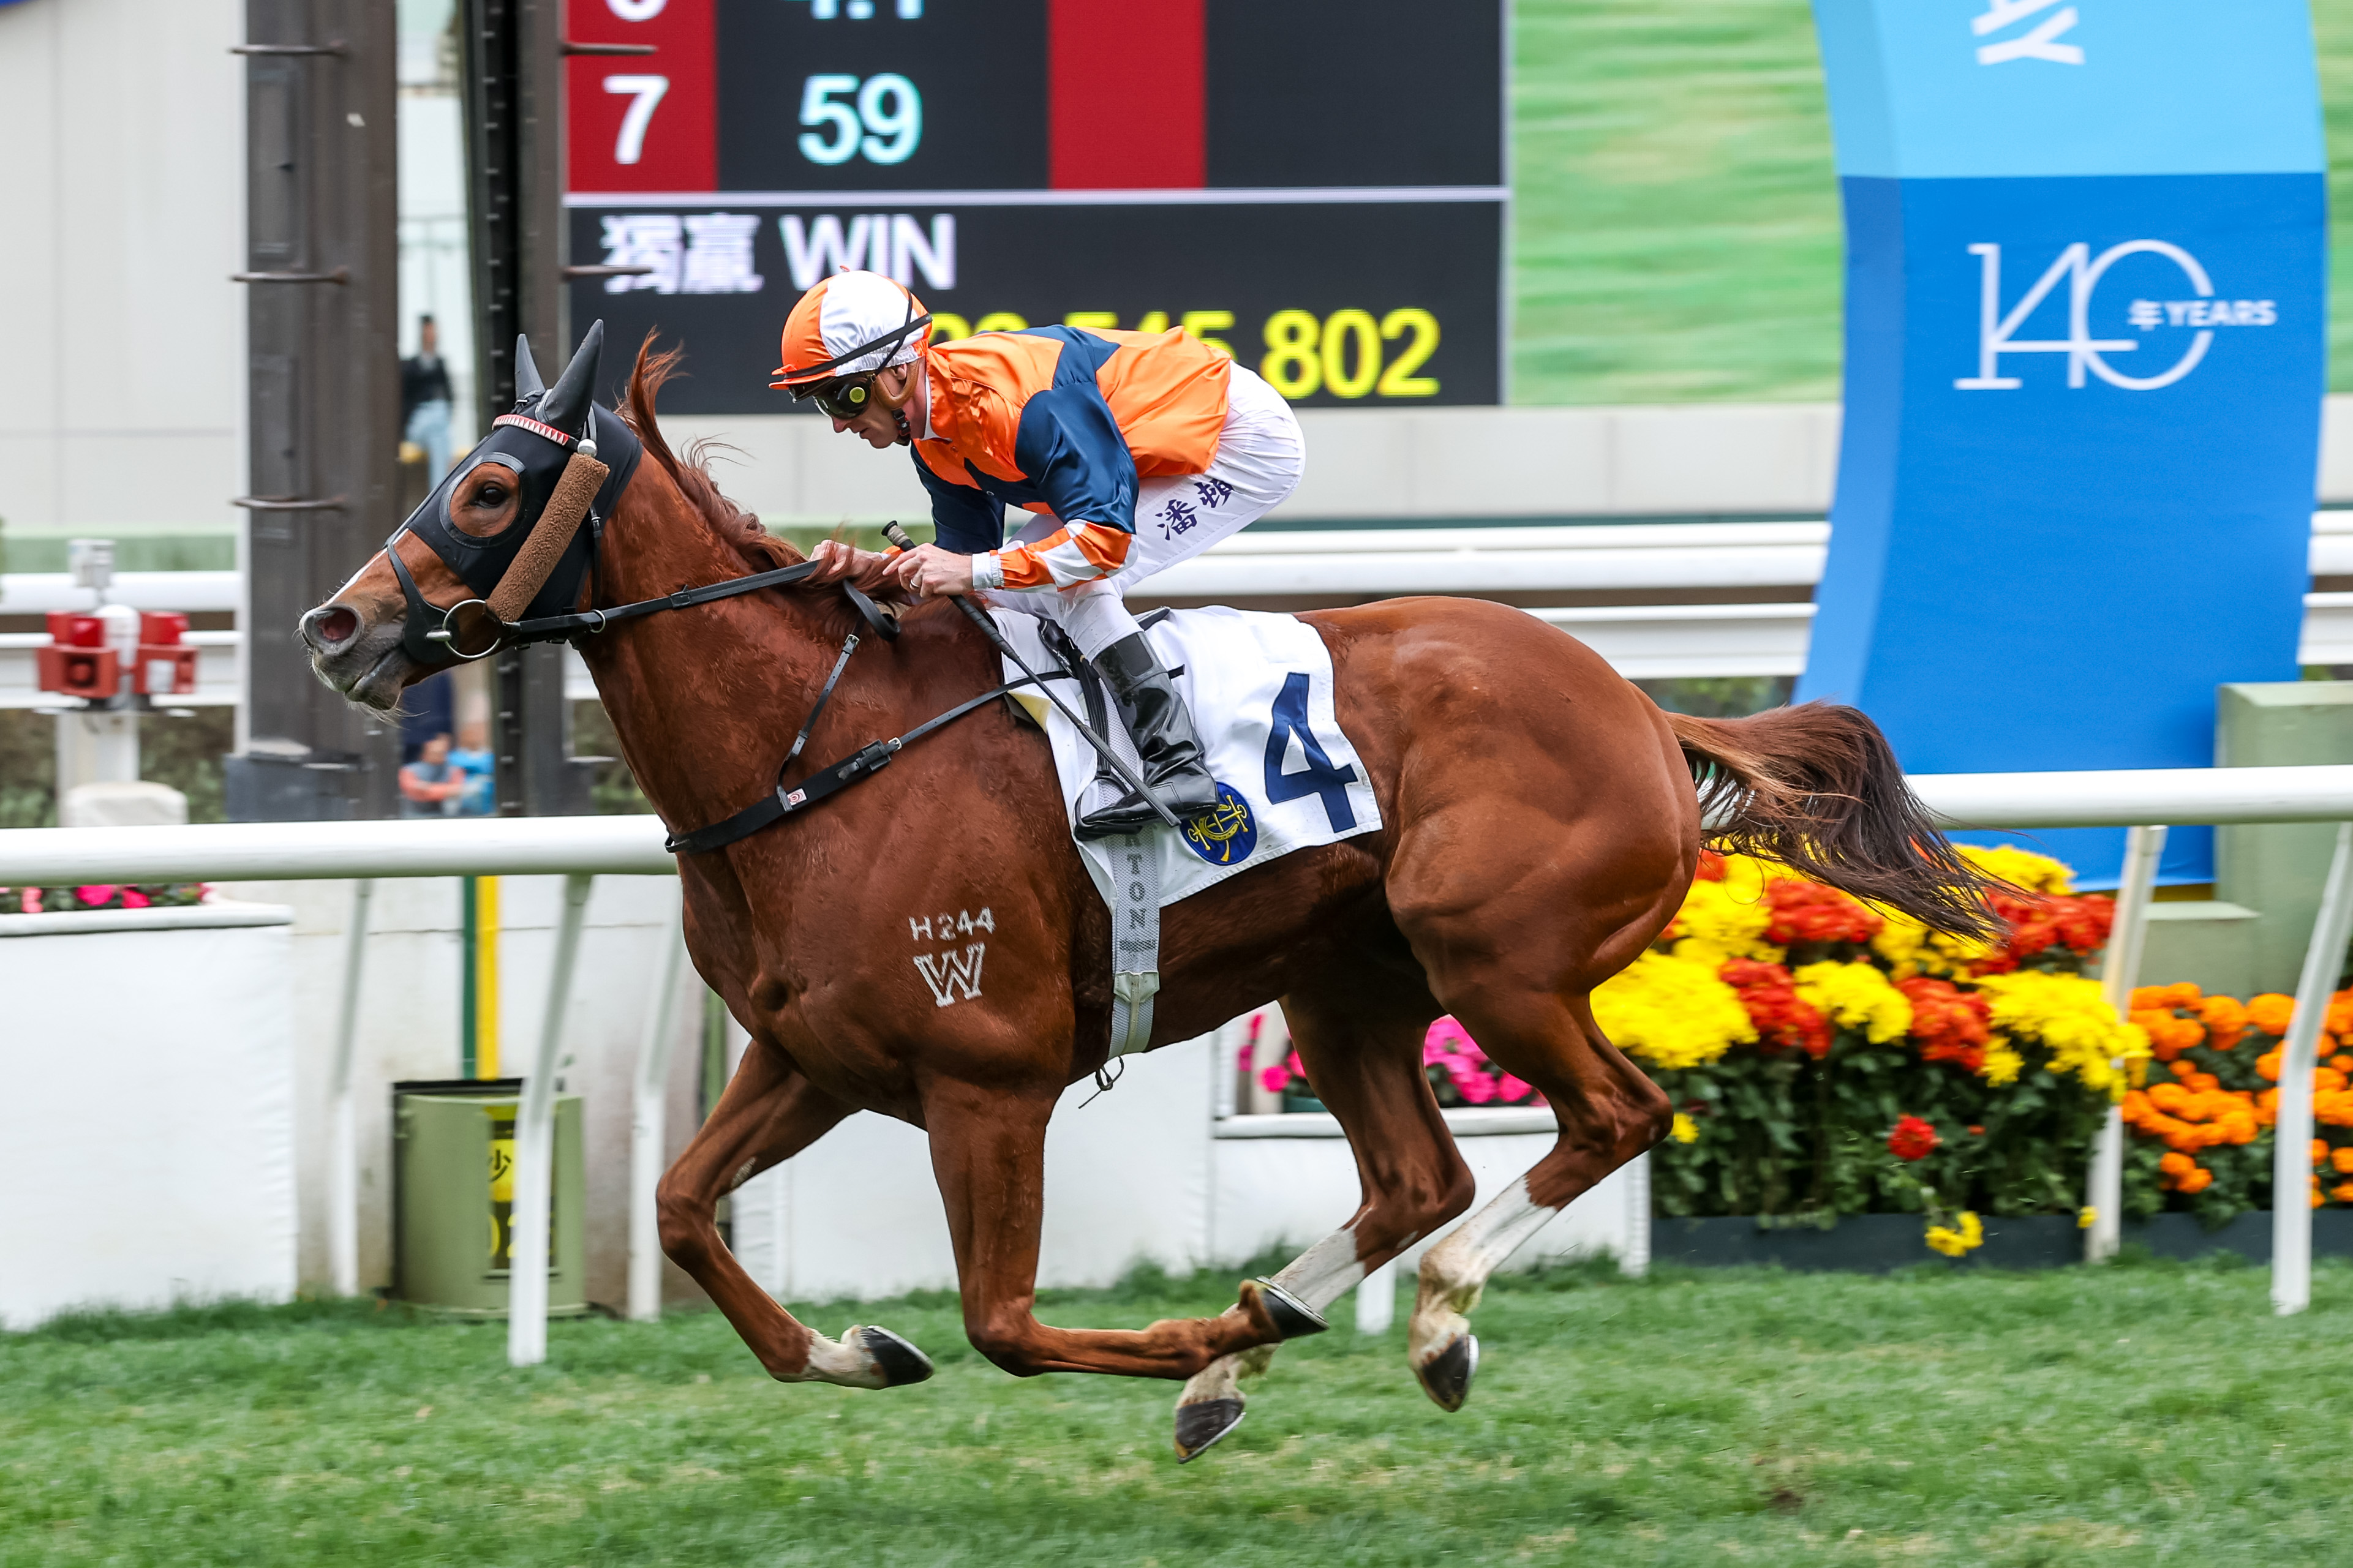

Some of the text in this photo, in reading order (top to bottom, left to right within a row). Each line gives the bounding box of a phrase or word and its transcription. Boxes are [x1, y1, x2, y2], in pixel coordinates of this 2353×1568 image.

[603, 75, 669, 165] 7
[799, 73, 922, 165] 59
[778, 214, 957, 290] WIN
[1954, 239, 2214, 391] 140
[1264, 672, 1358, 833] 4
[913, 941, 986, 1007] W
